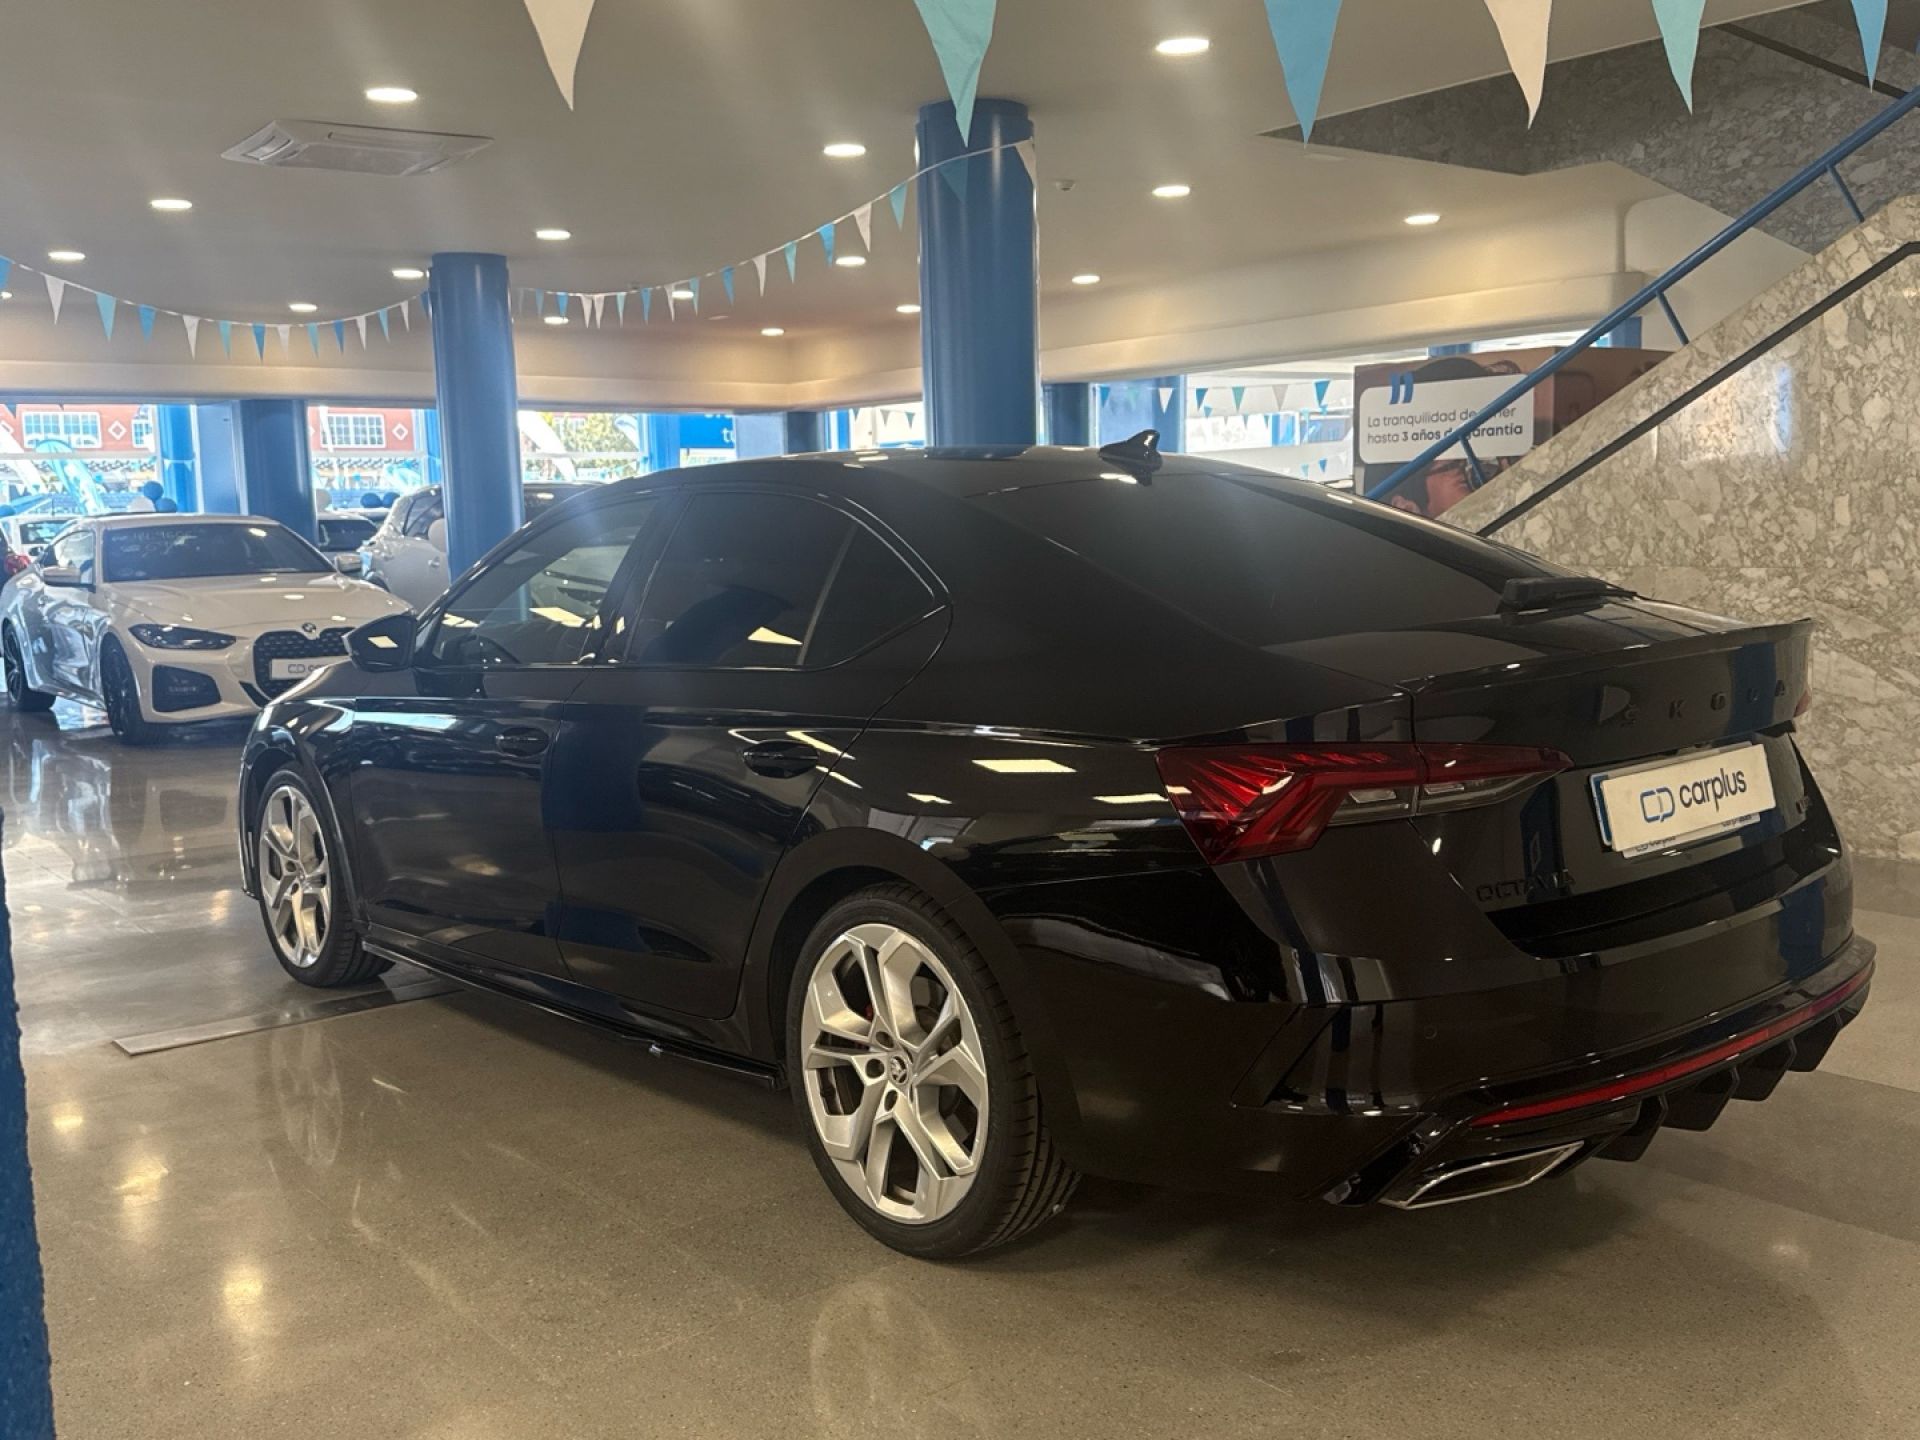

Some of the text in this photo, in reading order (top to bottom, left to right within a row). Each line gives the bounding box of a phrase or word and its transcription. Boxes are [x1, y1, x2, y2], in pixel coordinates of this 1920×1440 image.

[1367, 415, 1380, 428] La
[1383, 409, 1456, 427] tranquilidad
[1367, 431, 1400, 444] hasta
[1402, 431, 1409, 442] 3
[1411, 428, 1441, 441] años
[1679, 767, 1747, 812] carplus
